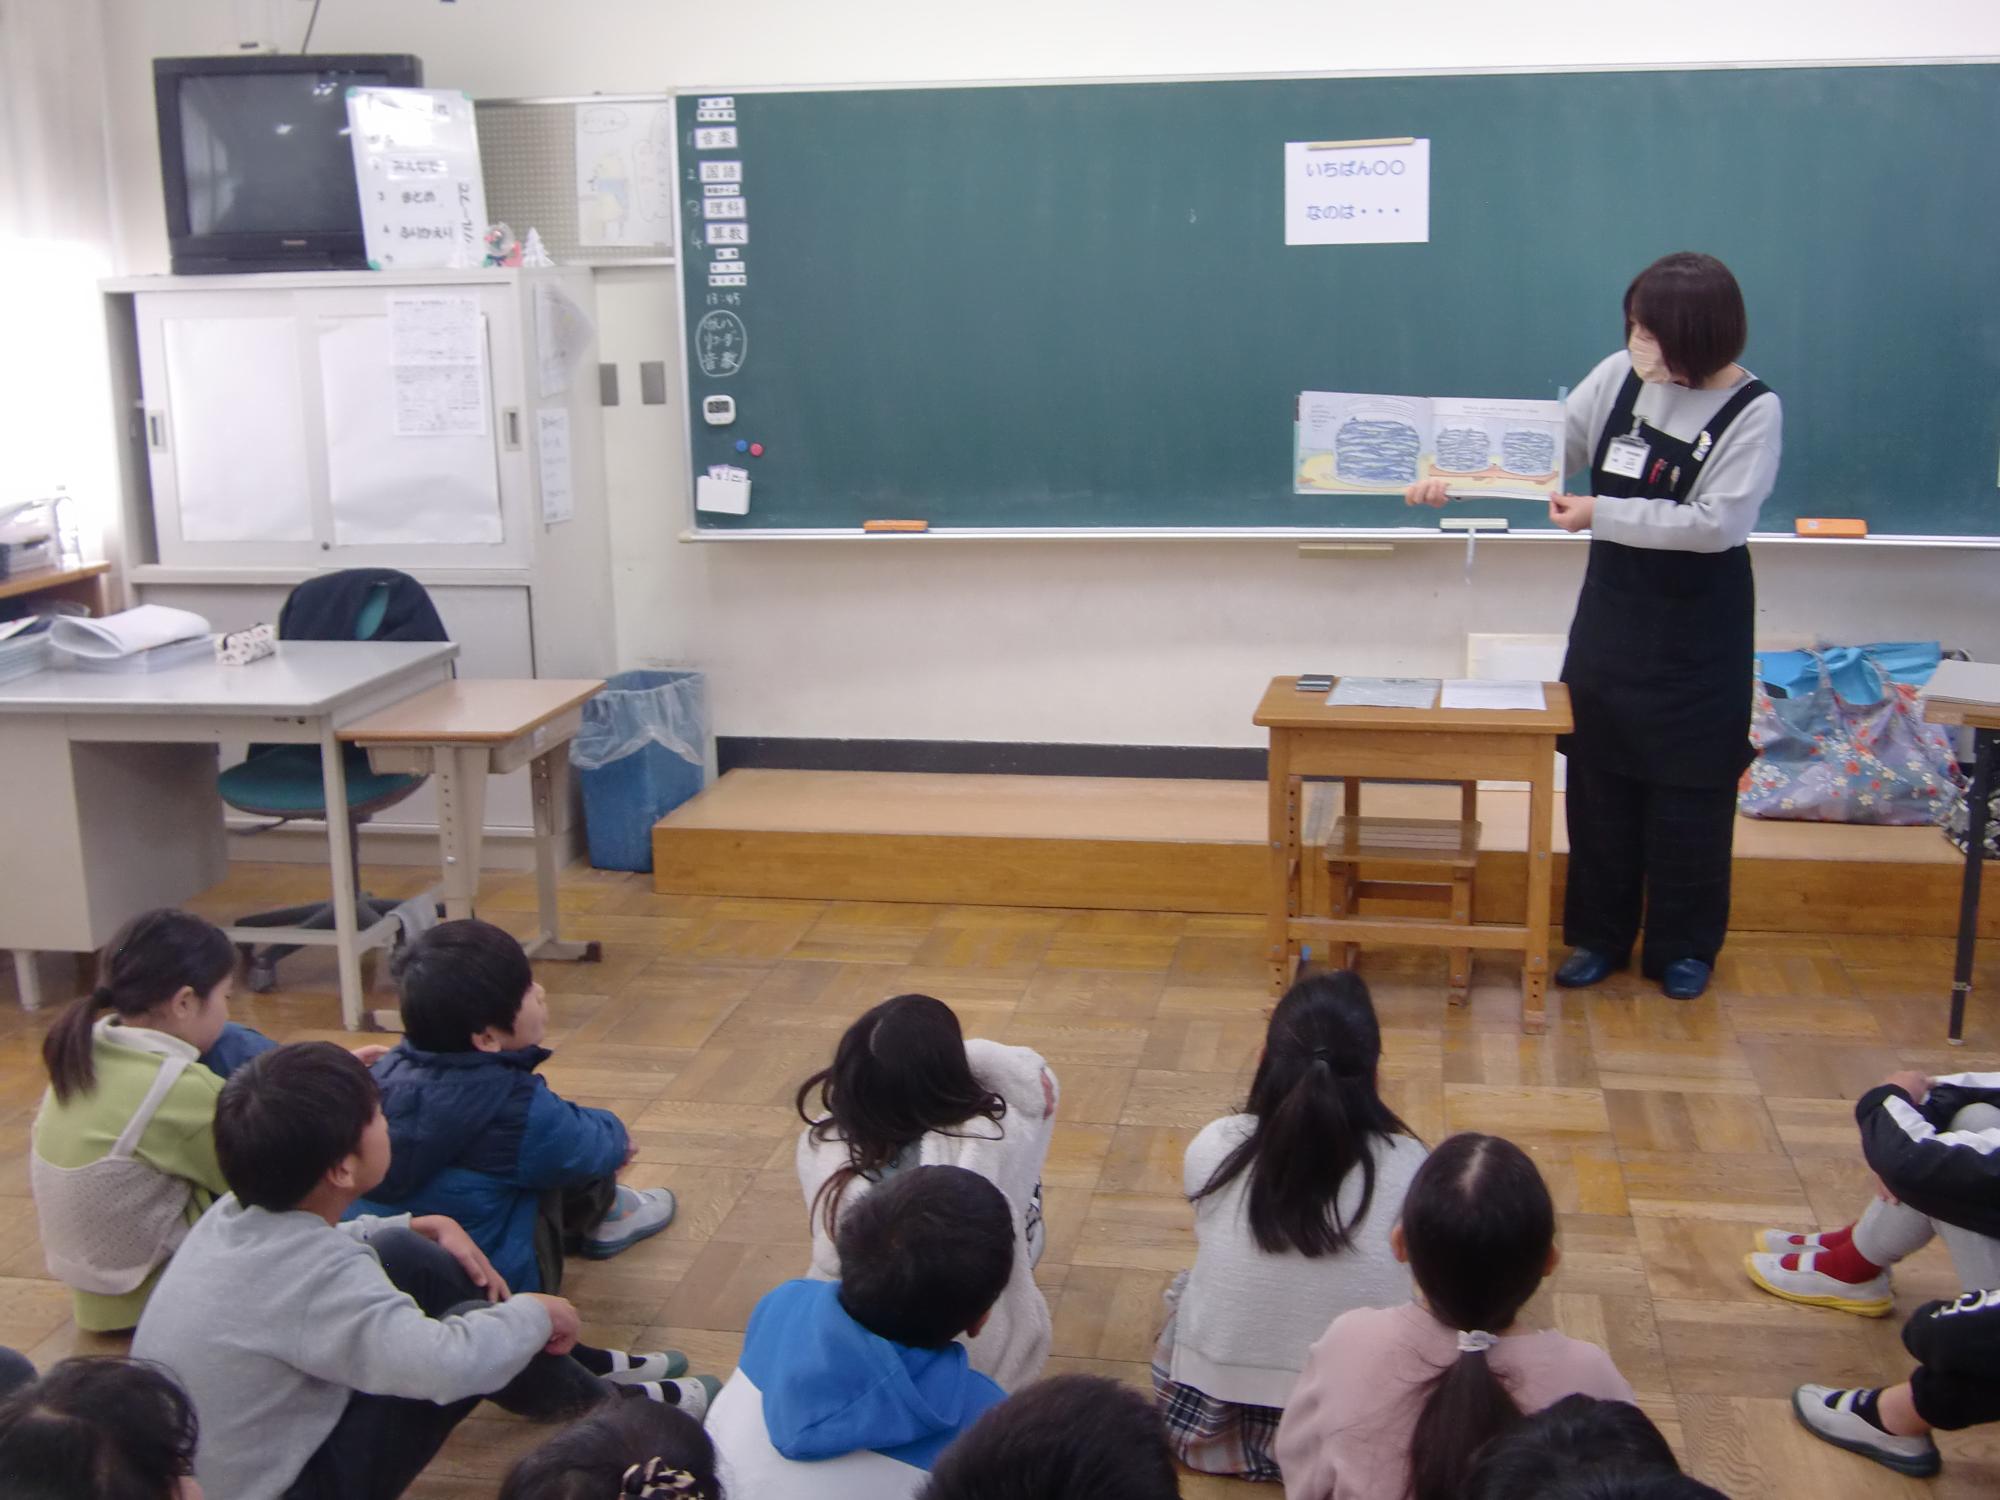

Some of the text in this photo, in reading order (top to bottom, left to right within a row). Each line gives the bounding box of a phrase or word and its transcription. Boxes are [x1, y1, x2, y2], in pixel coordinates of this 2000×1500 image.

[701, 130, 733, 145] 音楽
[705, 164, 737, 180] 国語
[709, 201, 740, 216] 理科
[711, 226, 745, 242] 算数
